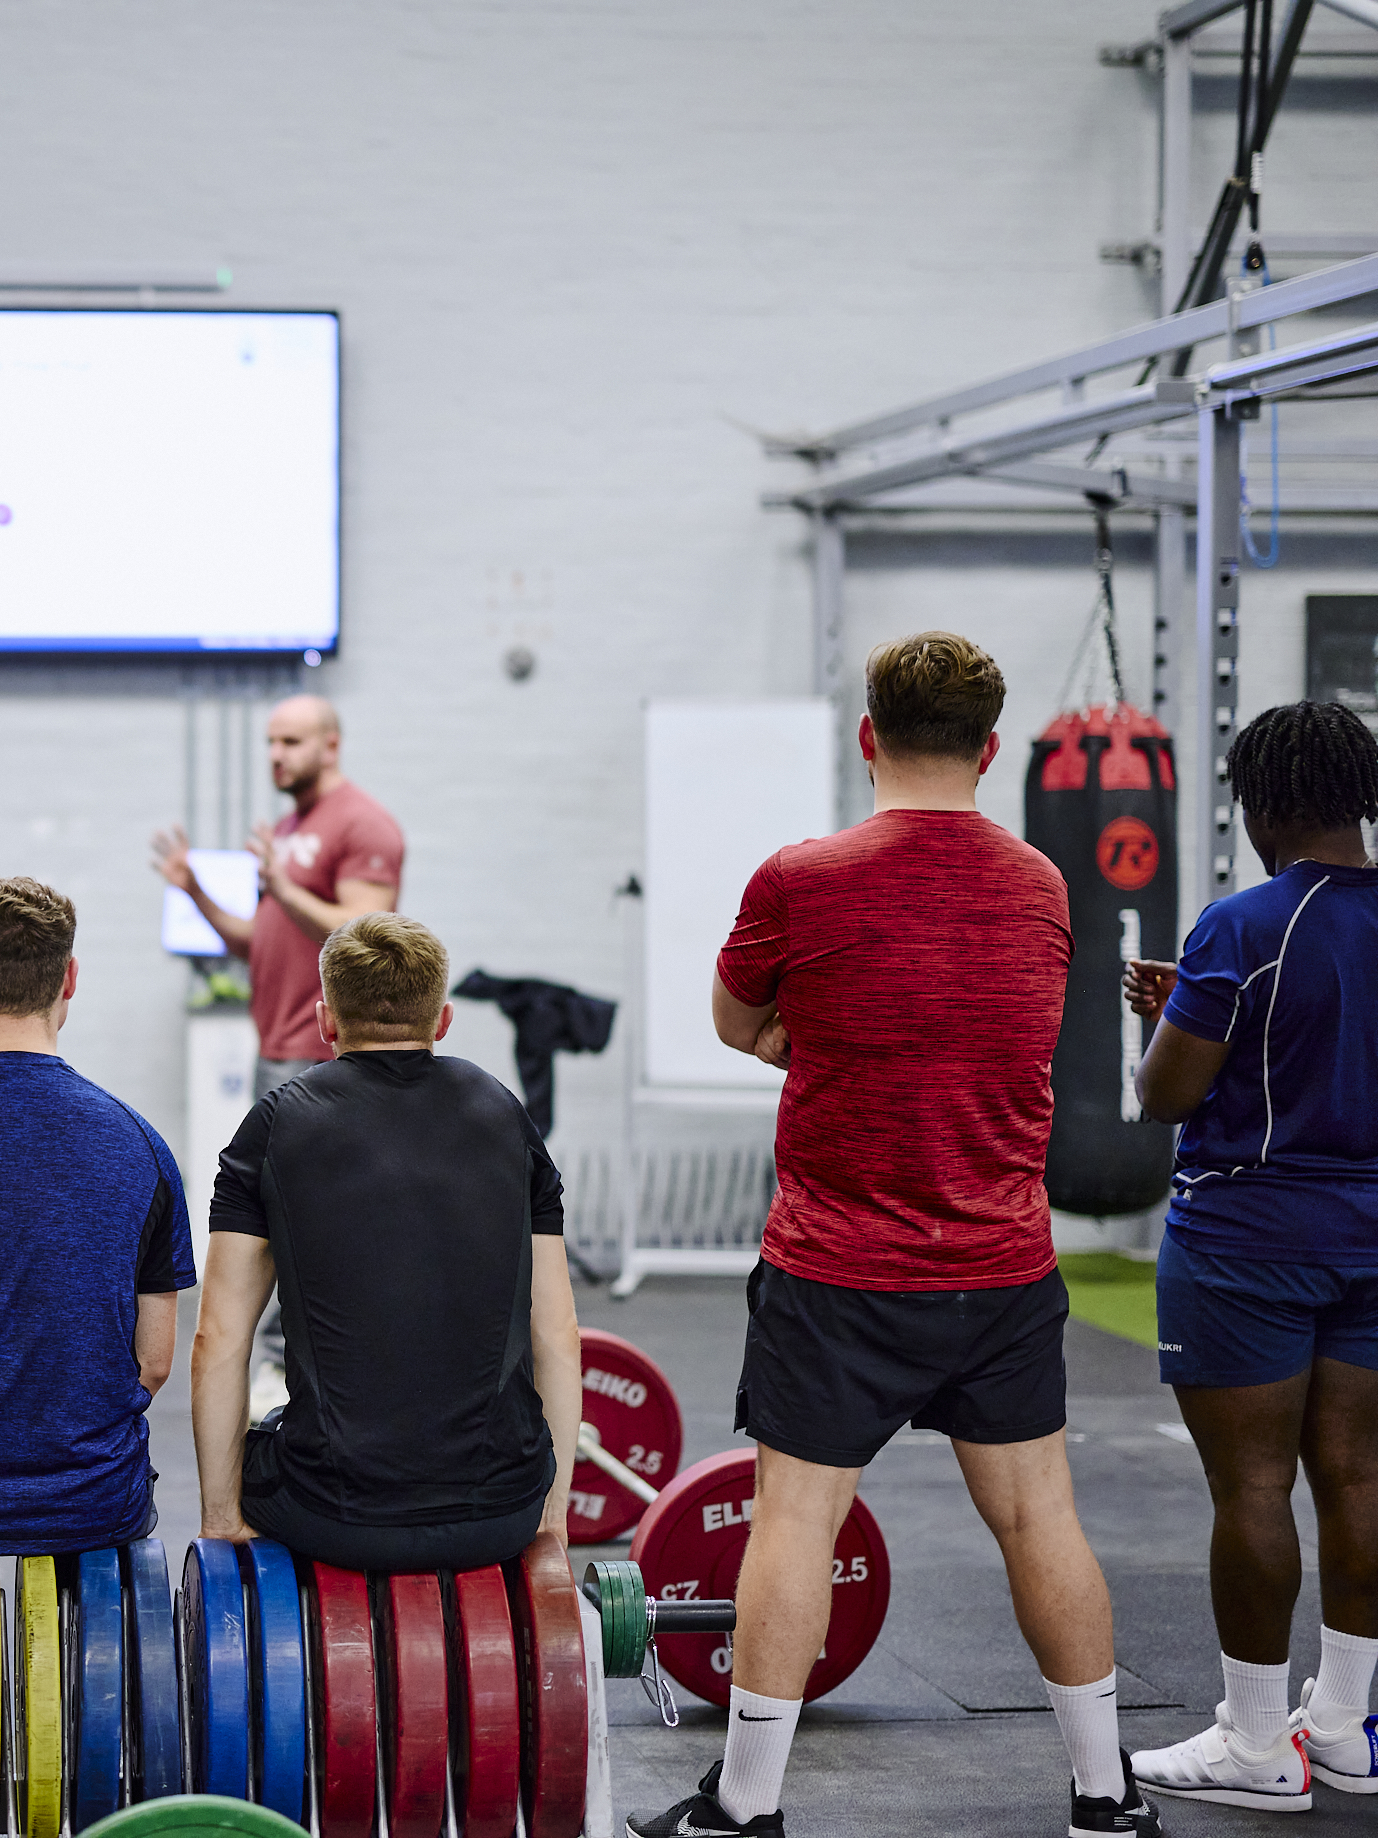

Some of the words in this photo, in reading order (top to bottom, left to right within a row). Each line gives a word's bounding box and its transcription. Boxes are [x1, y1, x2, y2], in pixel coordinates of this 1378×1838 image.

[582, 1366, 647, 1408] EIKO
[702, 1499, 755, 1533] ELE
[831, 1556, 868, 1584] 2.5
